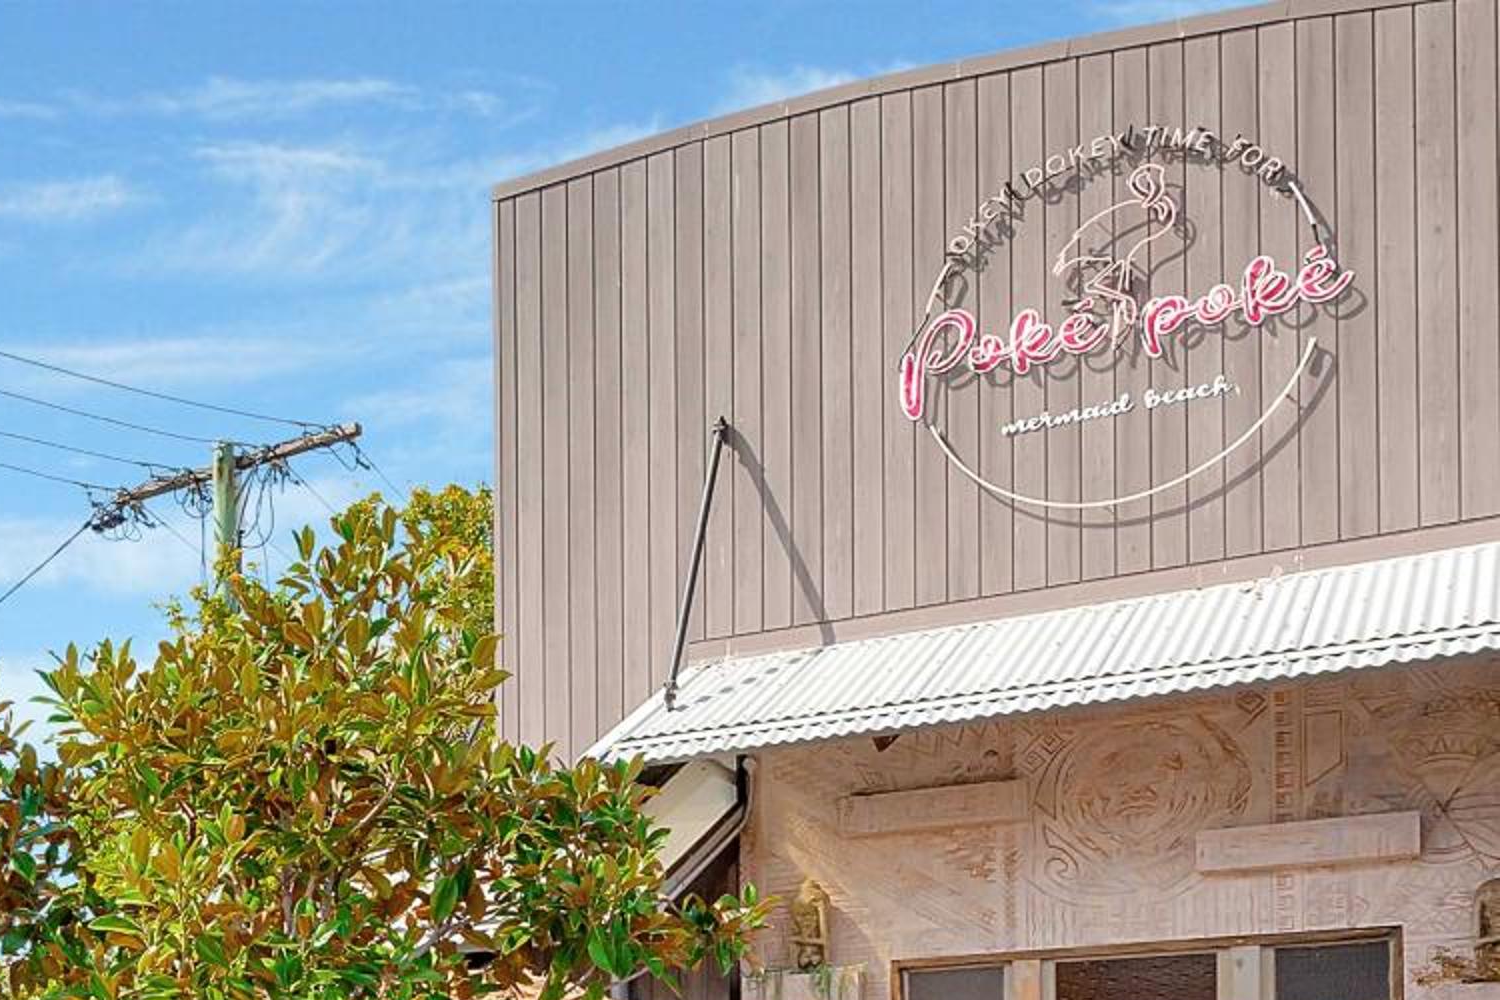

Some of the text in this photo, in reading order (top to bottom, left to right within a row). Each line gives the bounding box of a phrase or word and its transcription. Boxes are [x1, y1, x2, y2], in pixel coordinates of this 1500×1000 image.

[950, 124, 1282, 254] OKEY DOKEY TIME FOR
[1001, 392, 1135, 438] mermaid
